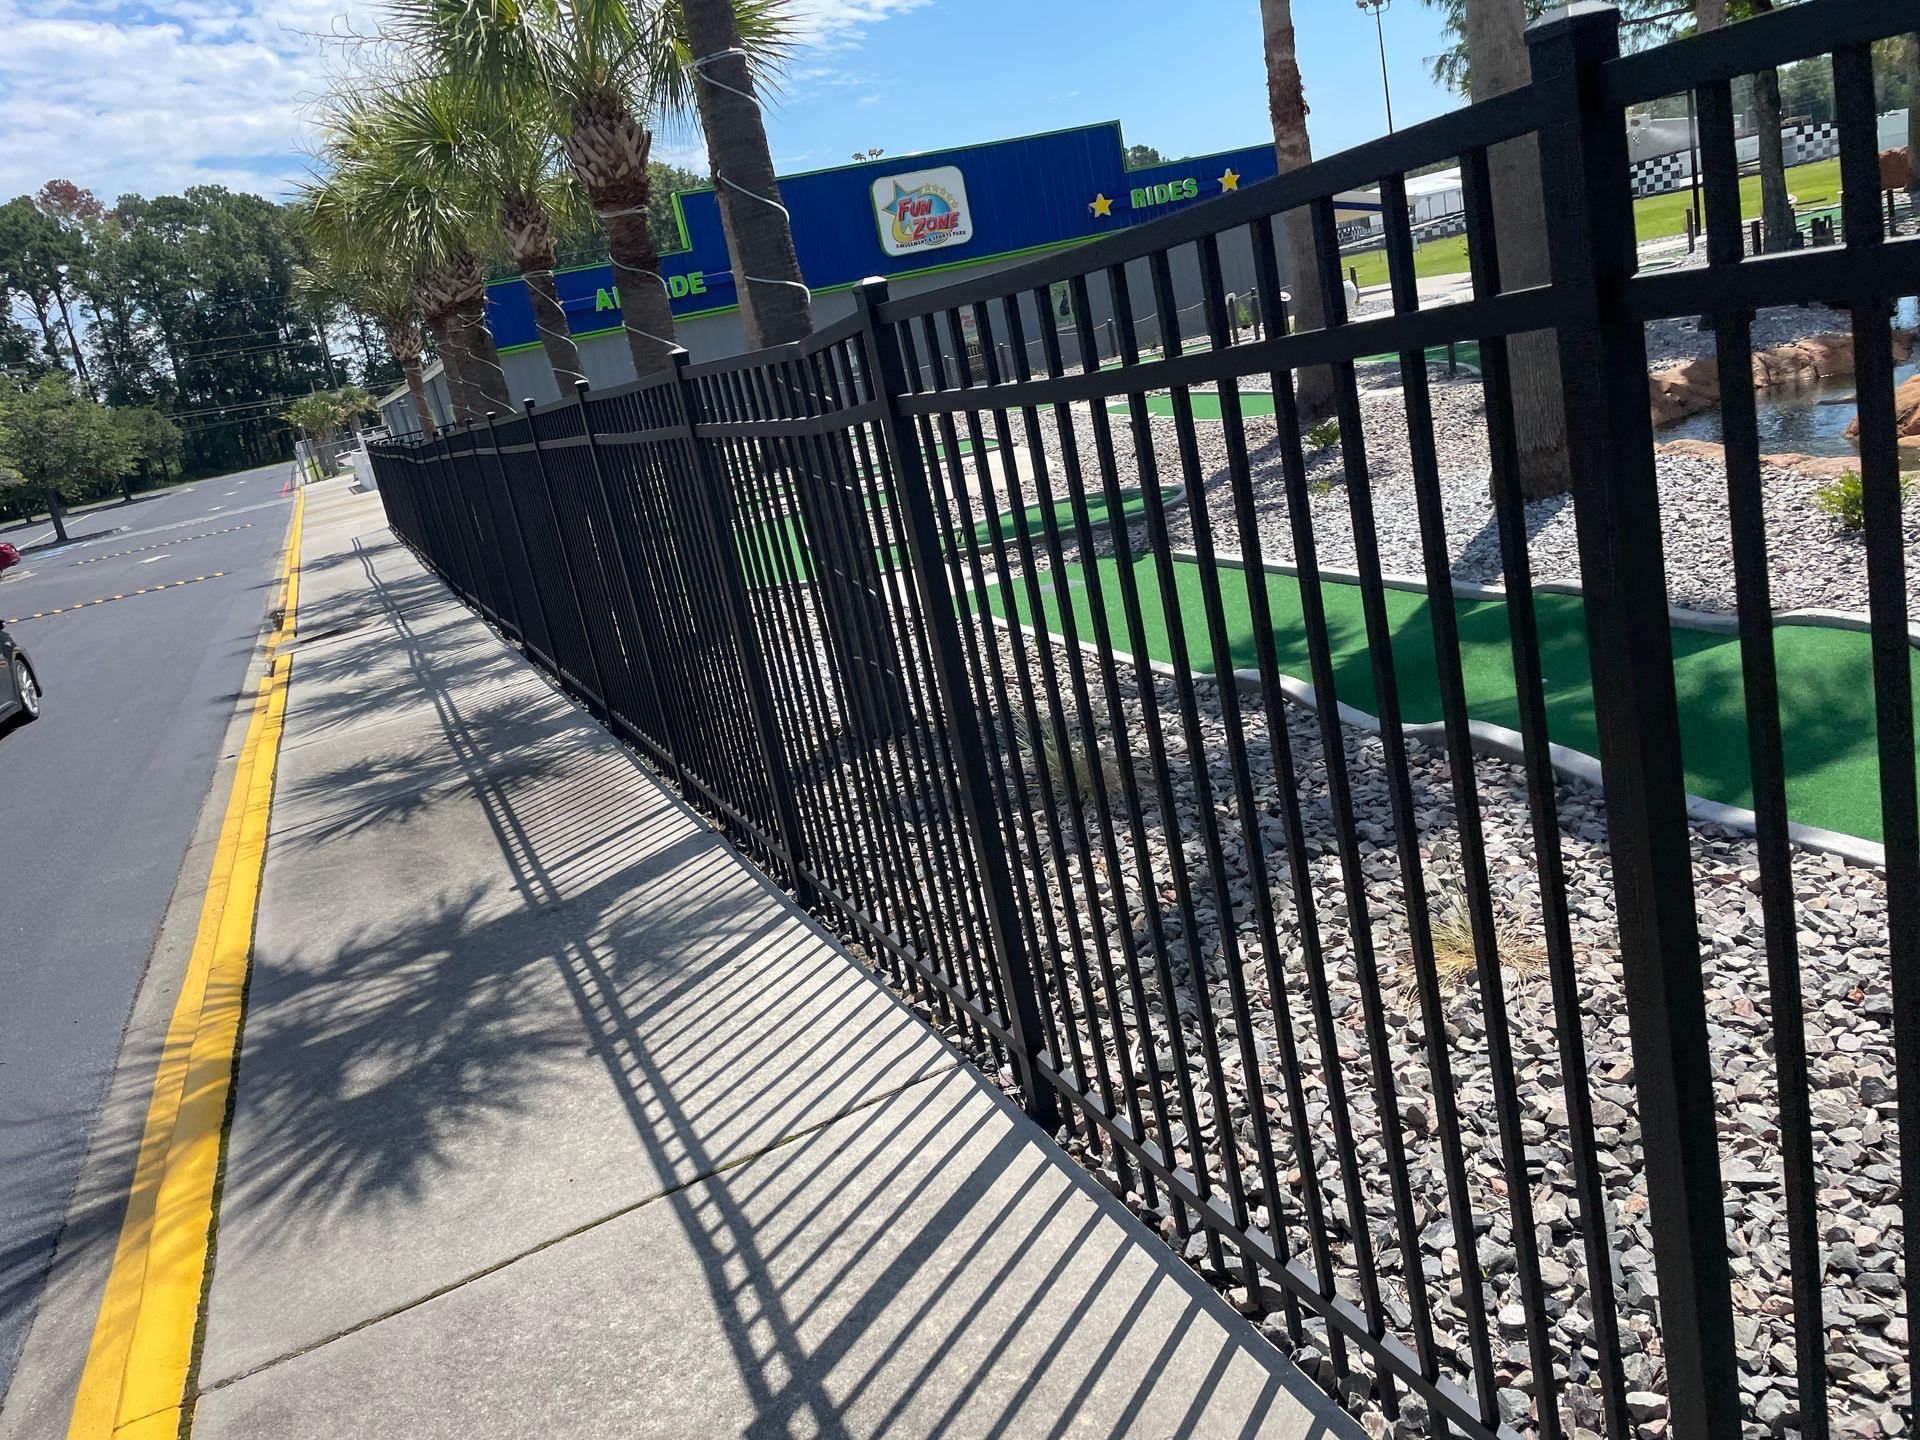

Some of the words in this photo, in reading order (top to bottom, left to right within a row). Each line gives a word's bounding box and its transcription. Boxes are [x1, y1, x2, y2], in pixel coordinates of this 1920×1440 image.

[1131, 178, 1198, 208] RIDES
[898, 197, 933, 222] FUN
[912, 212, 960, 240] ZONE
[896, 239, 927, 248] AMUSEMENT
[933, 233, 952, 241] SPORTS
[596, 271, 706, 312] ADE
